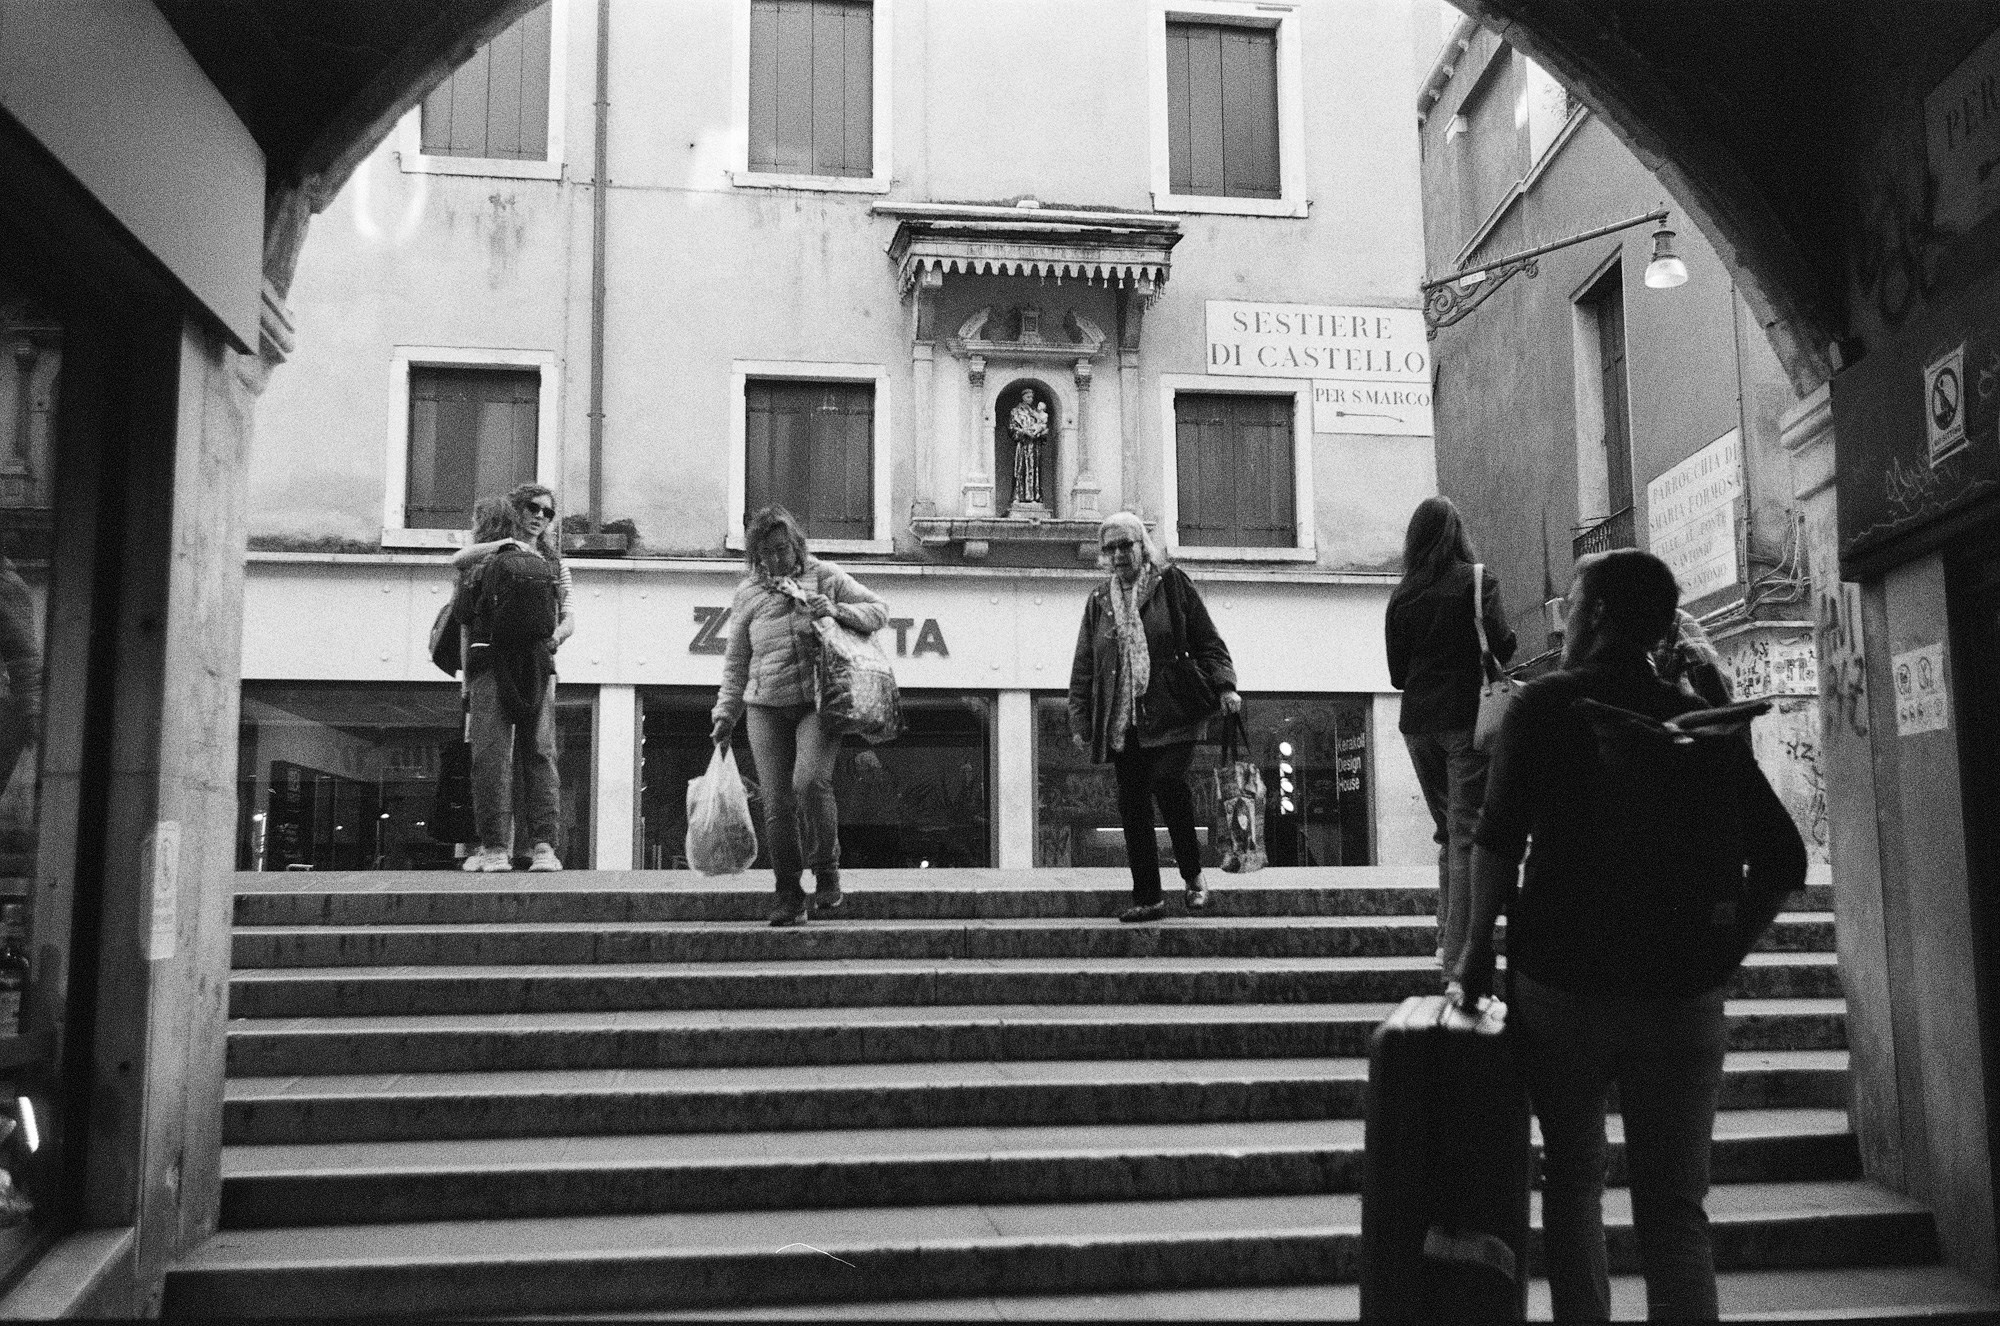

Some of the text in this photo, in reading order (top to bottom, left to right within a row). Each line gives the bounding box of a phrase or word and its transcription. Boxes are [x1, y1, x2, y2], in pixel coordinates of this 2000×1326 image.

[1233, 310, 1392, 339] SESTIERE
[1211, 343, 1425, 373] DI CASTELLO
[1315, 387, 1346, 403] PER
[1653, 442, 1738, 505] PARROCCHIA DI
[1688, 469, 1742, 513] FORMOSA
[1338, 756, 1362, 774] Design
[1339, 777, 1361, 792] House
